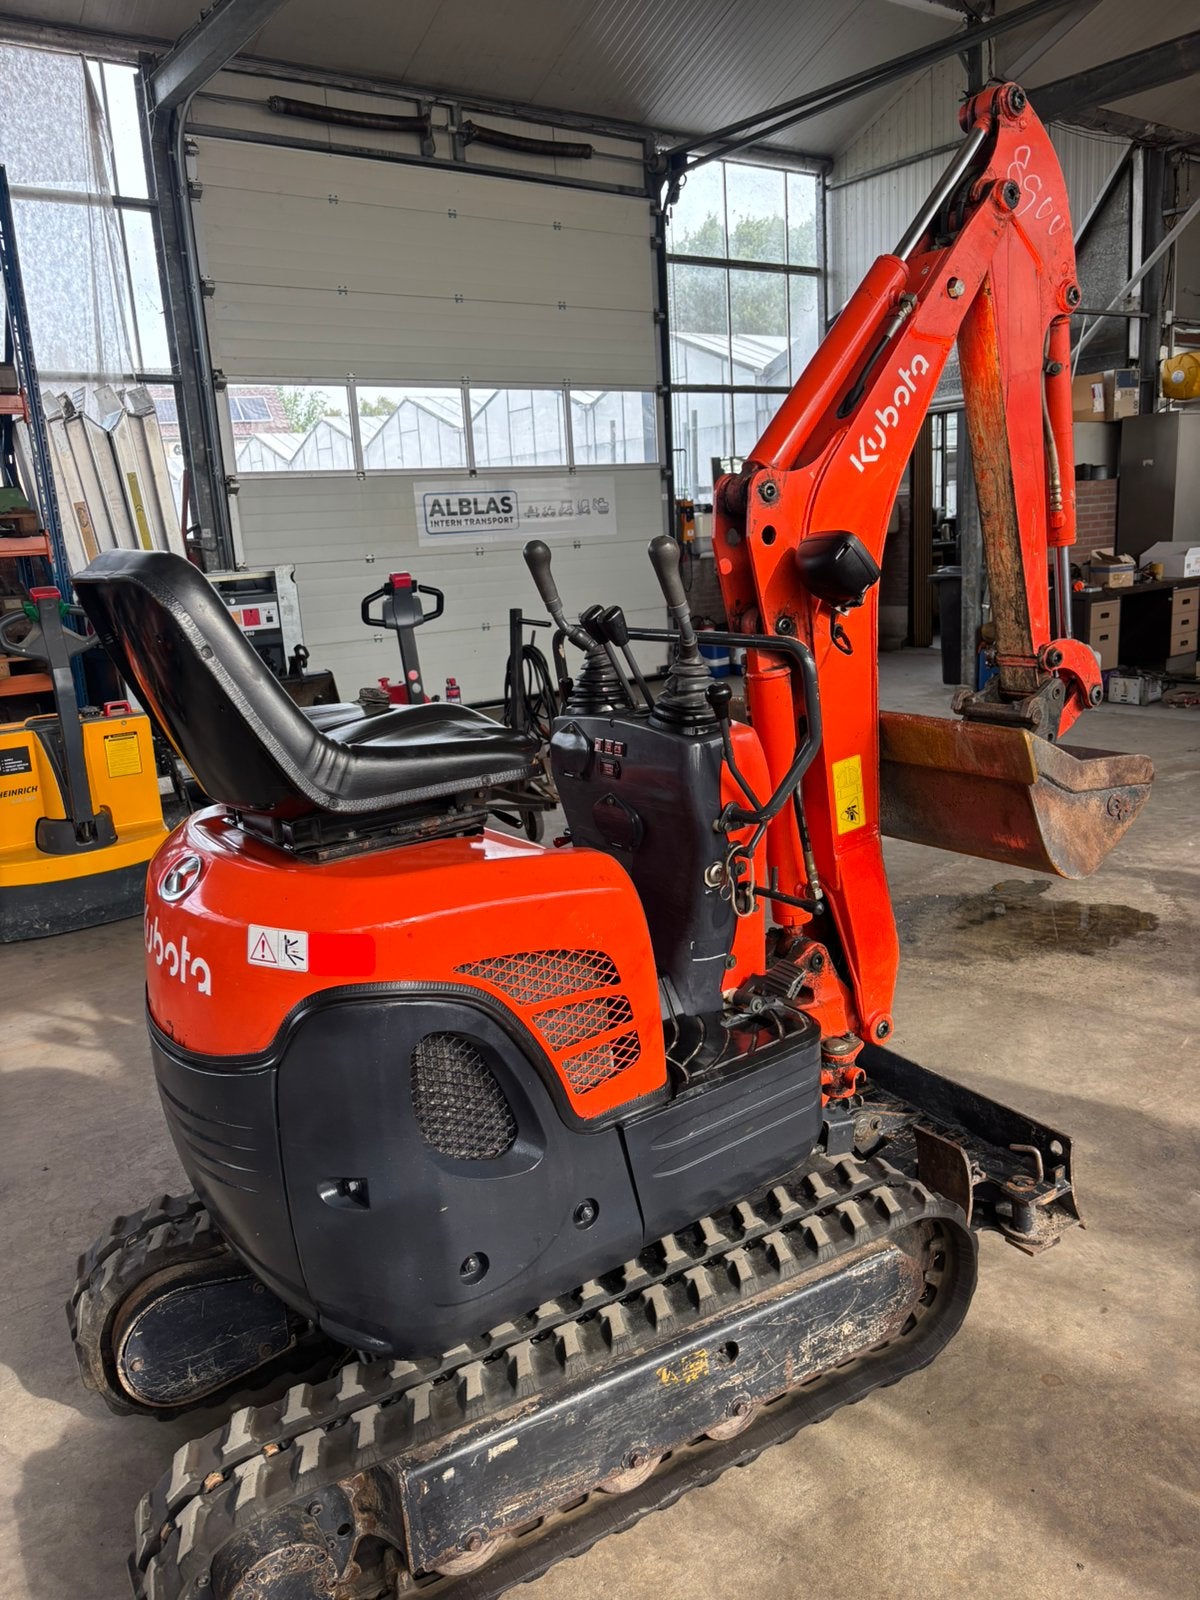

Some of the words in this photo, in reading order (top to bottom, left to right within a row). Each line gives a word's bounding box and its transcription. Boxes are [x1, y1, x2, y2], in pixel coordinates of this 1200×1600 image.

[849, 354, 930, 473] Kubota
[429, 496, 513, 517] ALBLAS
[430, 519, 463, 528] INTERN
[464, 516, 514, 526] TRANSPORT
